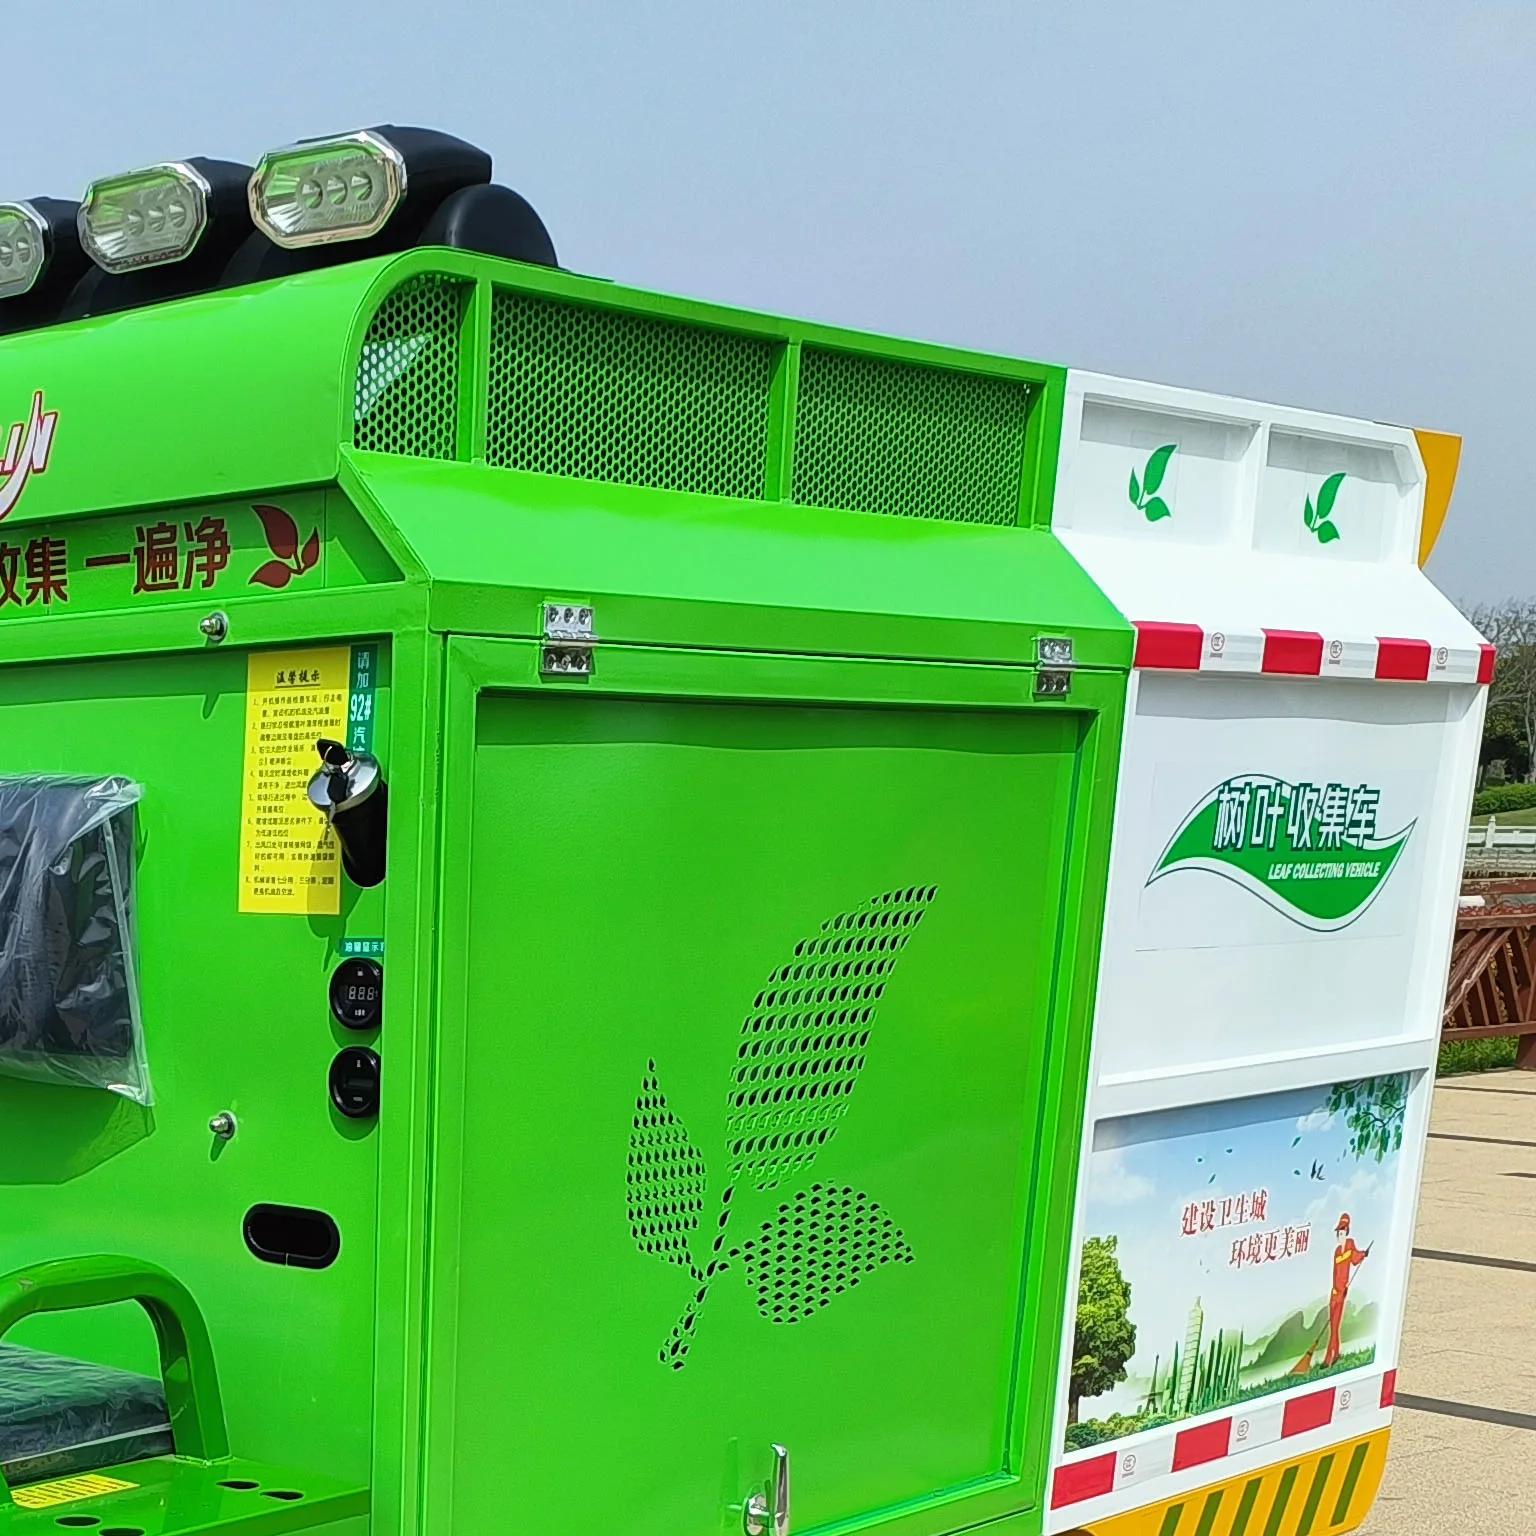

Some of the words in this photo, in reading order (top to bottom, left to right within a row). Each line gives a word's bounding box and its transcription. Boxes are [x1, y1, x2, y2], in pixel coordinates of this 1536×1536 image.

[85, 516, 231, 595] 一遍净
[1212, 782, 1381, 852] 树叶收集车
[1268, 863, 1292, 880] LEAF
[1292, 862, 1344, 879] COLLECTING
[1344, 861, 1381, 878] VEHICLE
[1181, 1189, 1268, 1237] 建设卫生城
[1229, 1222, 1311, 1269] 环境更美丽
